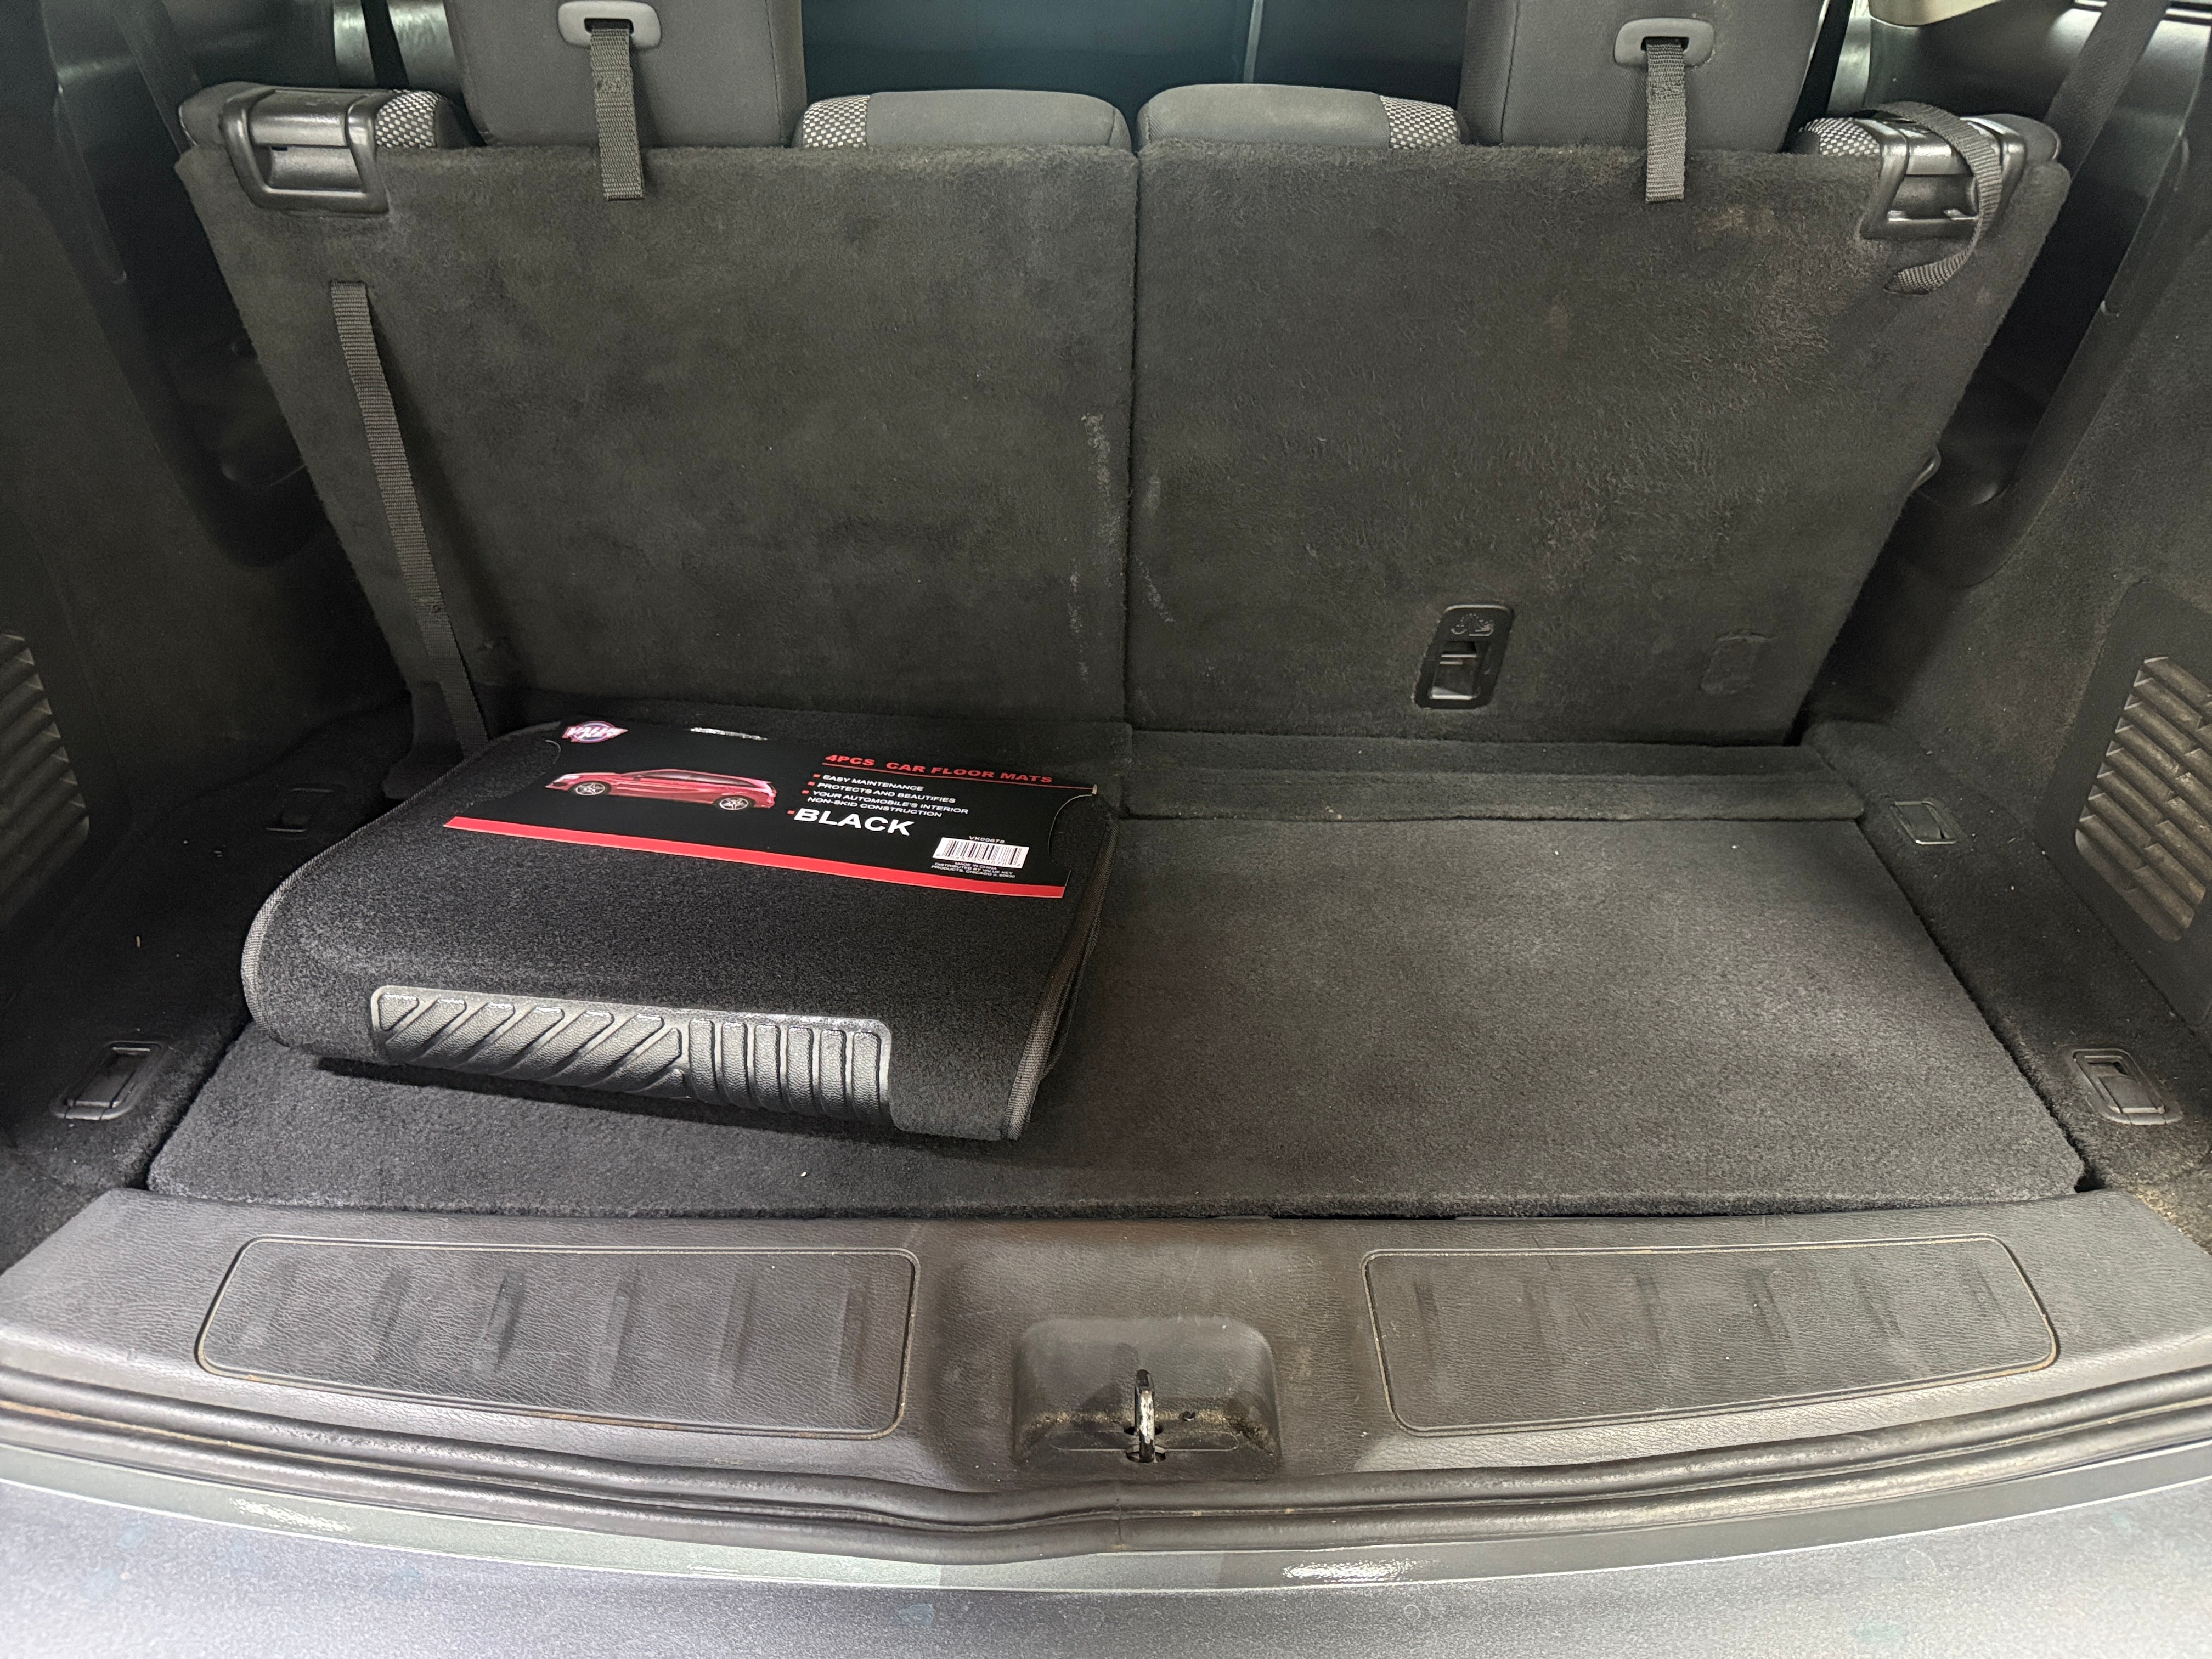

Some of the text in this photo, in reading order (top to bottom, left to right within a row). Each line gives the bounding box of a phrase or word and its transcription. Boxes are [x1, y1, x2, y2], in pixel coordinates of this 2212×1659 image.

[825, 754, 1053, 783] 4PCS CAR FLOOR MATS
[817, 782, 872, 794] PROTECTS
[897, 792, 956, 803] BEAUTIFIES
[822, 774, 924, 792] EASY MAINTENANCE
[807, 797, 943, 817] NON-SKID CONSTRUCTION
[812, 790, 969, 815] YOUR AUTOMOBILE'S INTERIOR
[794, 808, 915, 836] BLACK
[969, 836, 1005, 844] VK00678
[934, 862, 972, 870] DISTRIBUTED
